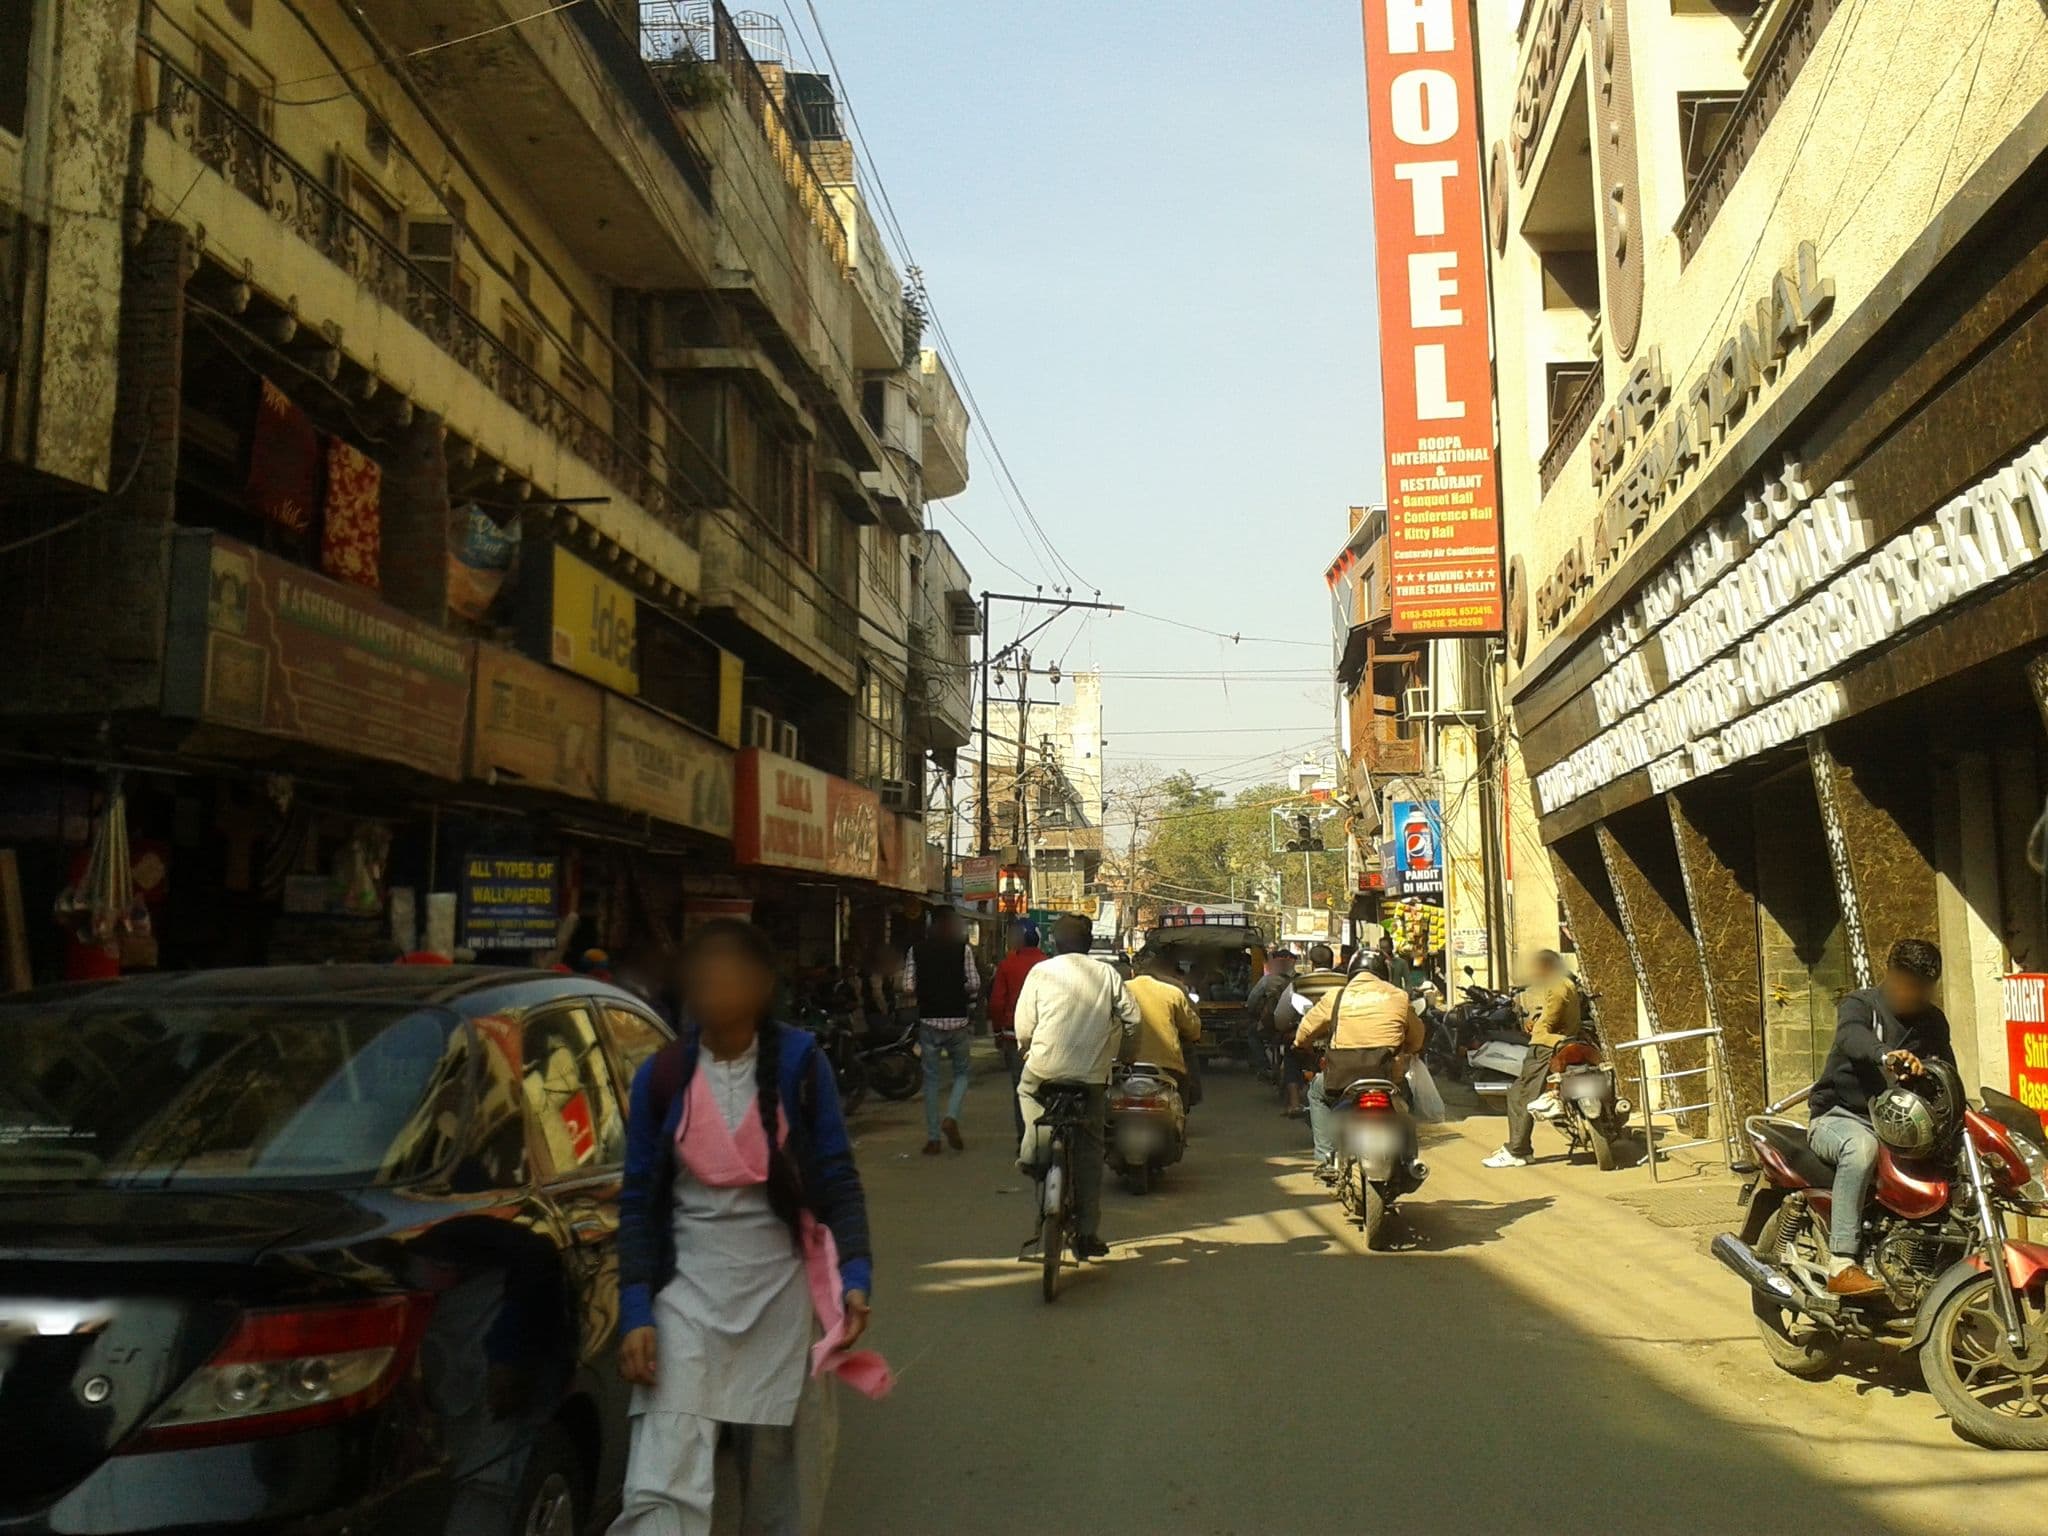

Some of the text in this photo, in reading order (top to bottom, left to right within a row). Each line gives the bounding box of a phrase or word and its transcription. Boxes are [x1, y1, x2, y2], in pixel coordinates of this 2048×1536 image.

[1386, 0, 1466, 420] HOTEL
[1589, 344, 1673, 489] HOTEL
[1418, 435, 1462, 451] ROOPA
[1535, 240, 1837, 632] ROOPA INTERNATIONAL
[1391, 447, 1490, 466] INTERNATIONAL
[1436, 464, 1446, 477] &
[1400, 474, 1484, 493] RESTAURANT
[1402, 490, 1474, 508] Banquet Hall
[1404, 506, 1493, 524] Conference Hall
[1404, 524, 1454, 541] Kitty Hall
[1426, 570, 1464, 582] HAVING
[1395, 581, 1497, 597] THREE STAR FACILITY
[1591, 479, 1876, 728] ROOPA INTERNATIONAL
[470, 860, 555, 879] ALL TYPES OF
[1405, 869, 1440, 880] PANDIT
[472, 887, 551, 905] WALLPAPERS
[1403, 883, 1415, 893] DI
[2003, 978, 2046, 1022] BRIGHT
